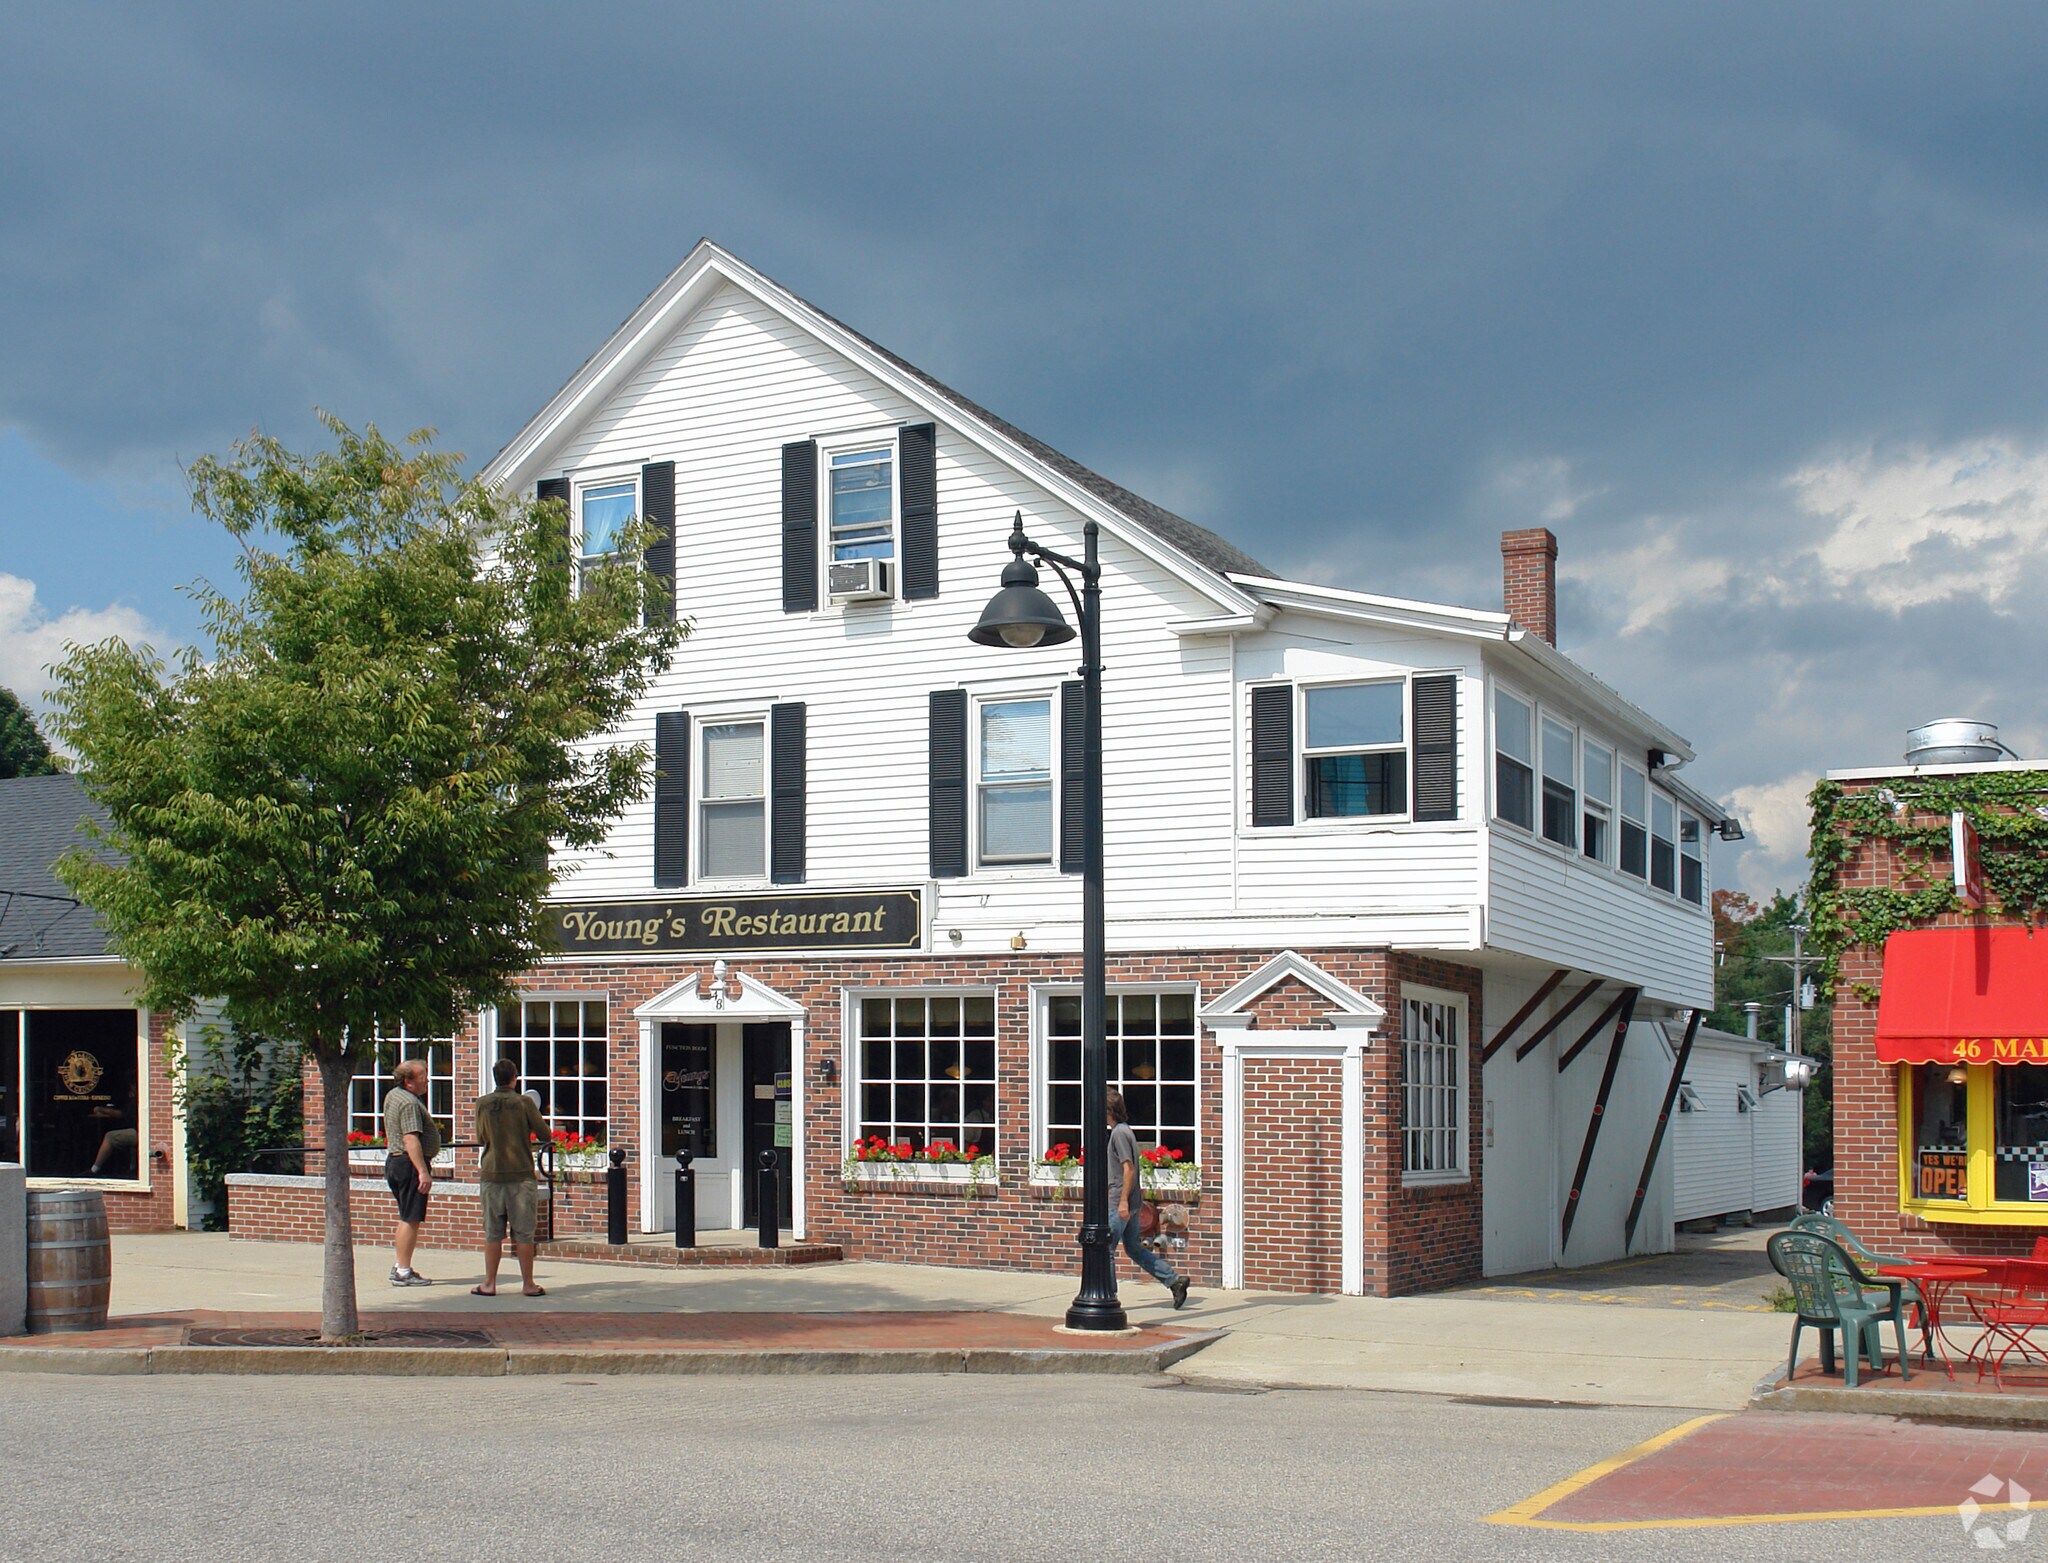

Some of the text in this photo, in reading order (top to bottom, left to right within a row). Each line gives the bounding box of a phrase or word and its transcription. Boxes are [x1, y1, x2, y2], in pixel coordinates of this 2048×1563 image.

[562, 904, 886, 945] Young's Restaurant
[1953, 1038, 2048, 1058] 46 MAI
[1923, 1154, 1968, 1167] YES WE'R
